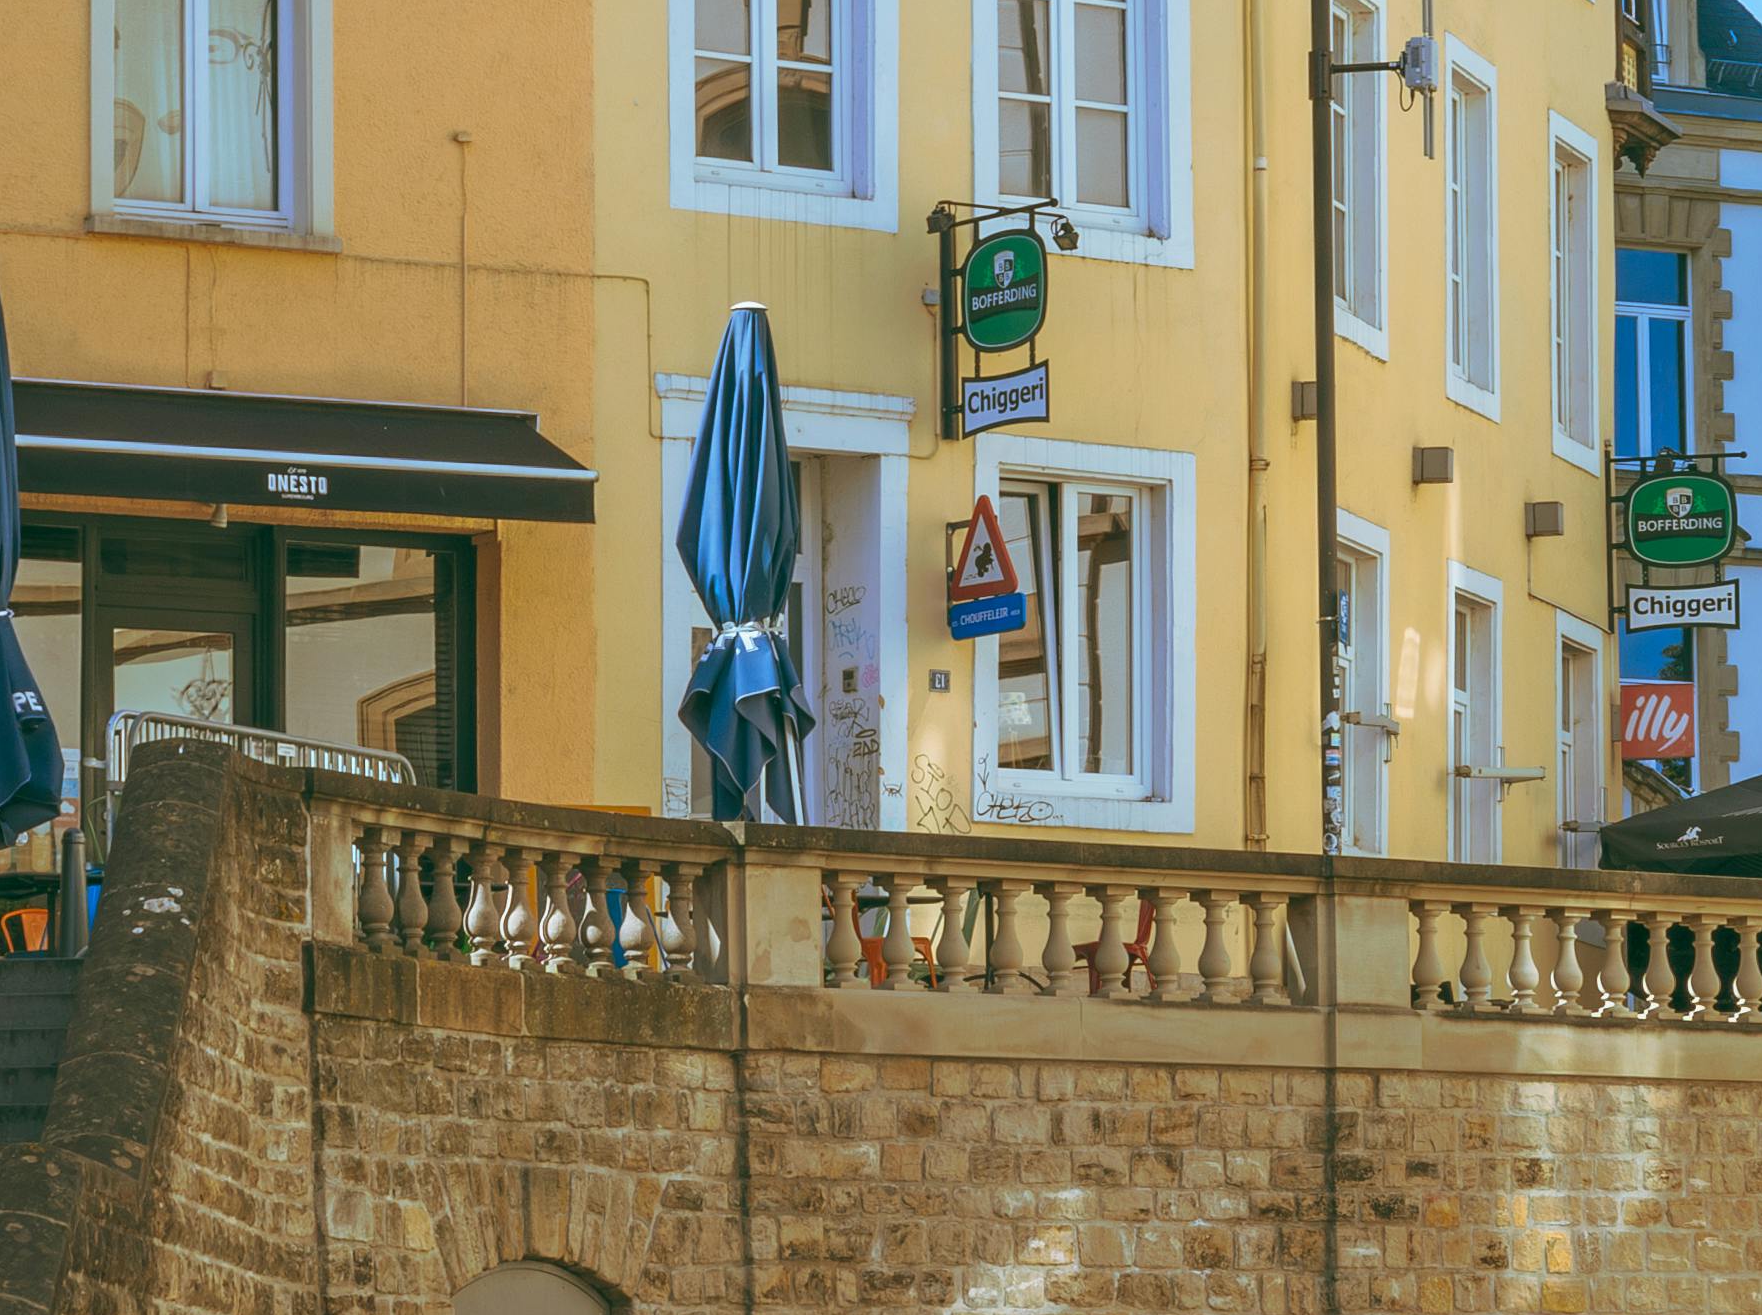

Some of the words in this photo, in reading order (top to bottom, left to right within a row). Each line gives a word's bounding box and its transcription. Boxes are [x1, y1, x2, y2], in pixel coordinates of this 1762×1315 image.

[971, 283, 1037, 311] BOFFERDING
[967, 377, 1044, 414] Chiggeri
[268, 473, 328, 495] ONESTO
[1637, 517, 1723, 532] BOFFERDING
[1633, 592, 1733, 618] Chiggeri
[1625, 694, 1690, 752] illy
